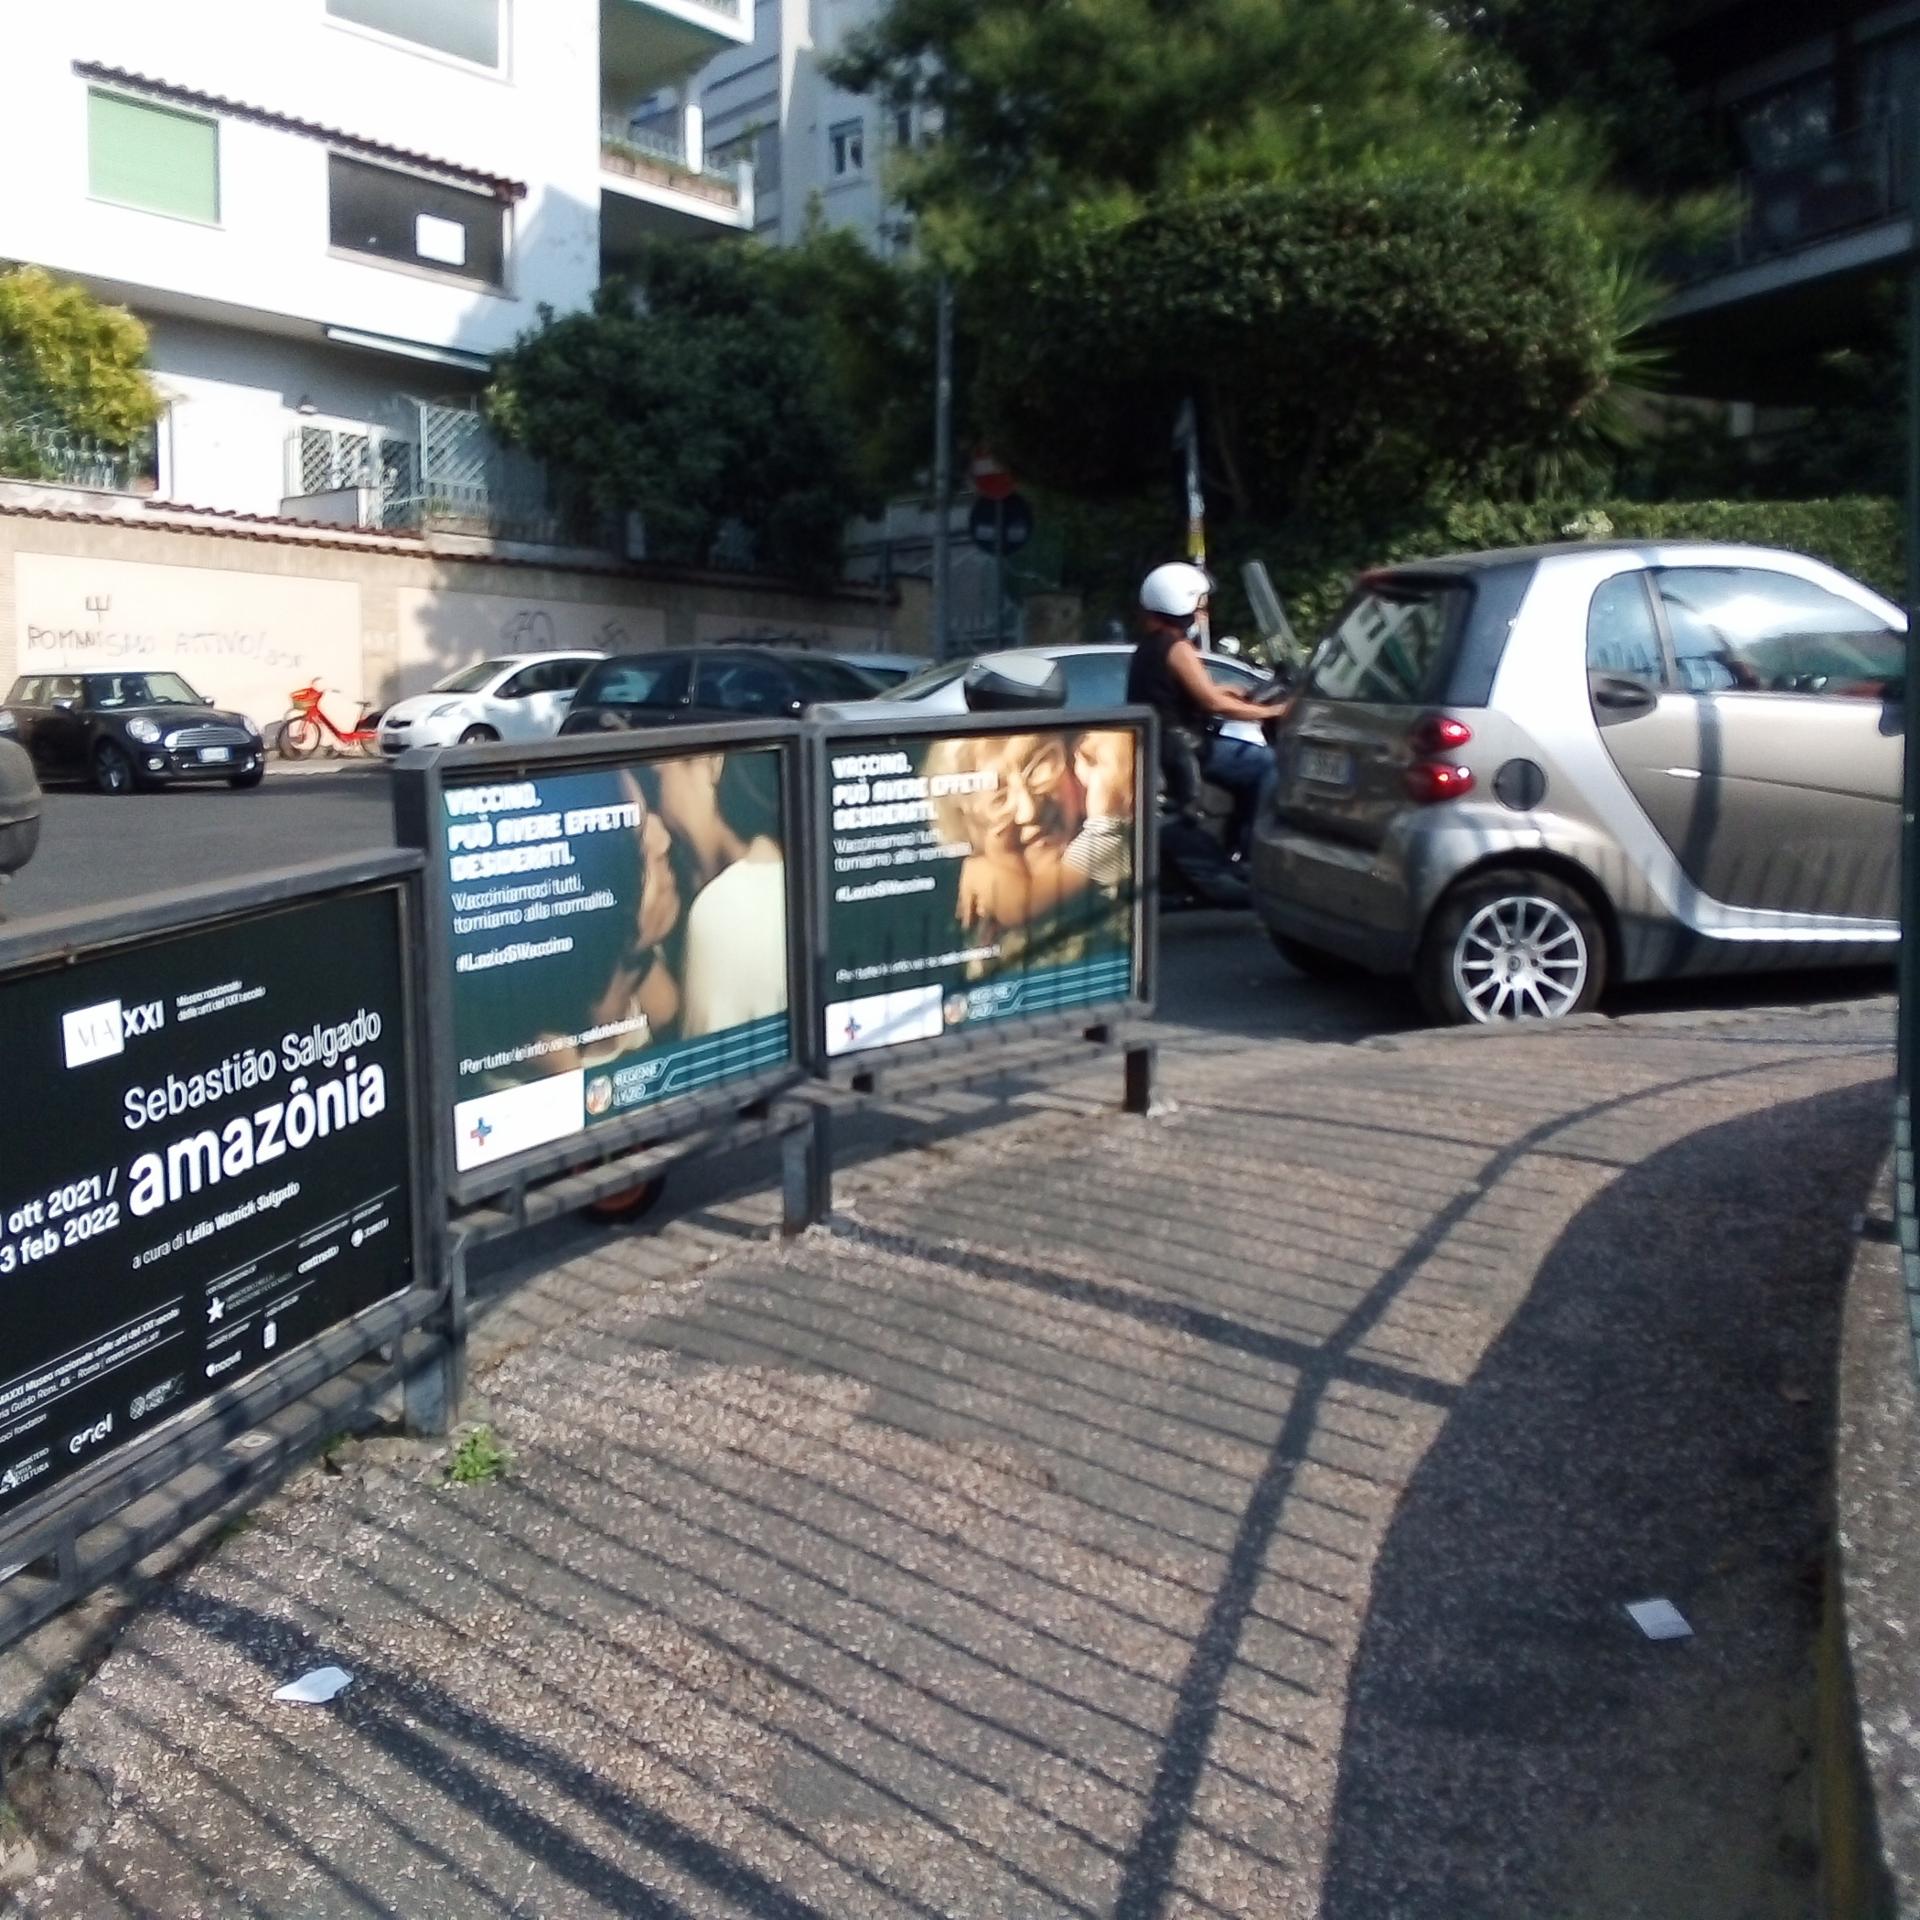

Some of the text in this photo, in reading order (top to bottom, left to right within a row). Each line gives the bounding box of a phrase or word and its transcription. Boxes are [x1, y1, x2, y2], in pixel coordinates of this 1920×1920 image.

[564, 801, 641, 836] EFFETTI
[124, 1008, 382, 1130] Sebastião Salgado
[128, 1055, 386, 1217] amazônia
[8, 1199, 44, 1234] ott
[47, 1175, 101, 1219] 2021
[19, 1229, 61, 1265] feb
[63, 1201, 120, 1247] 2022
[69, 1412, 113, 1454] enel
